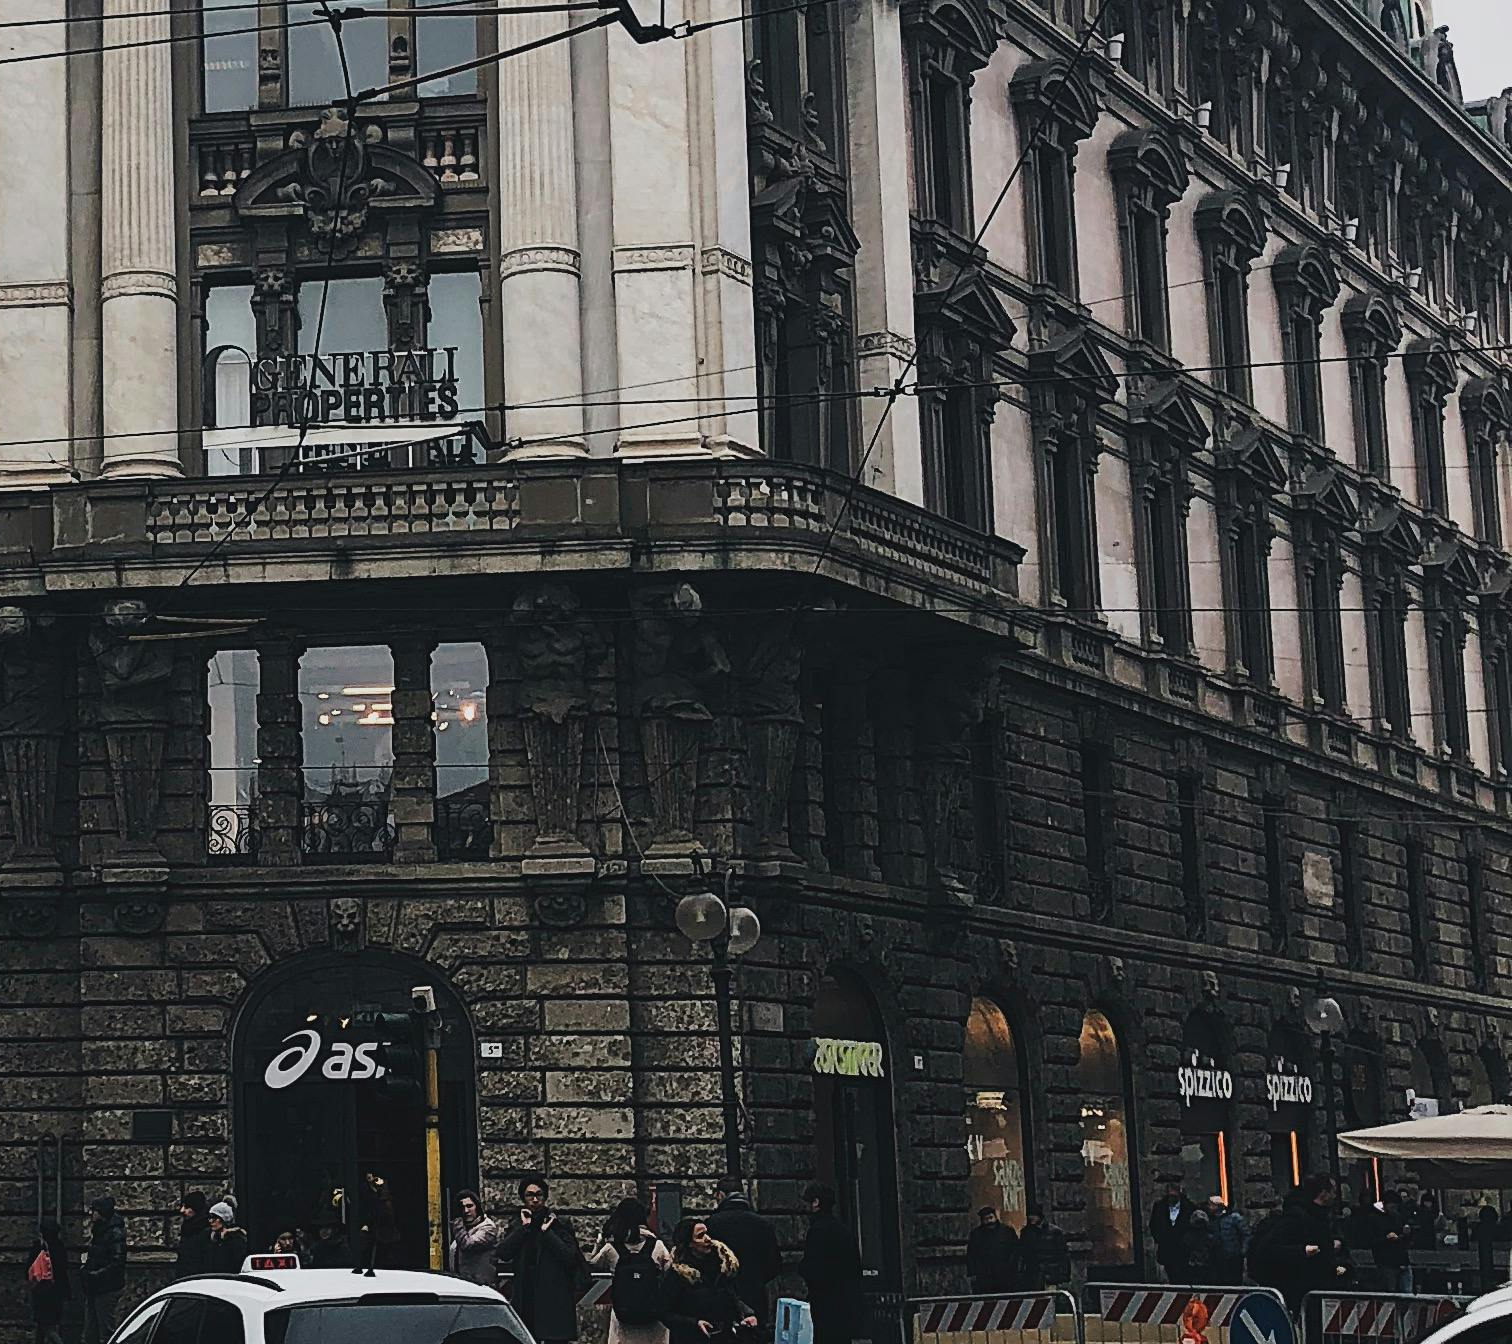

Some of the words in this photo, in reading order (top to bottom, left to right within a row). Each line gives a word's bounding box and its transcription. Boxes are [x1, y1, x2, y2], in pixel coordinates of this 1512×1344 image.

[251, 346, 459, 392] GENERALI
[249, 382, 459, 429] PROPERTIES
[1178, 1048, 1233, 1108] spizzico
[1266, 1056, 1313, 1112] spizzico
[252, 1257, 295, 1269] TAXI
